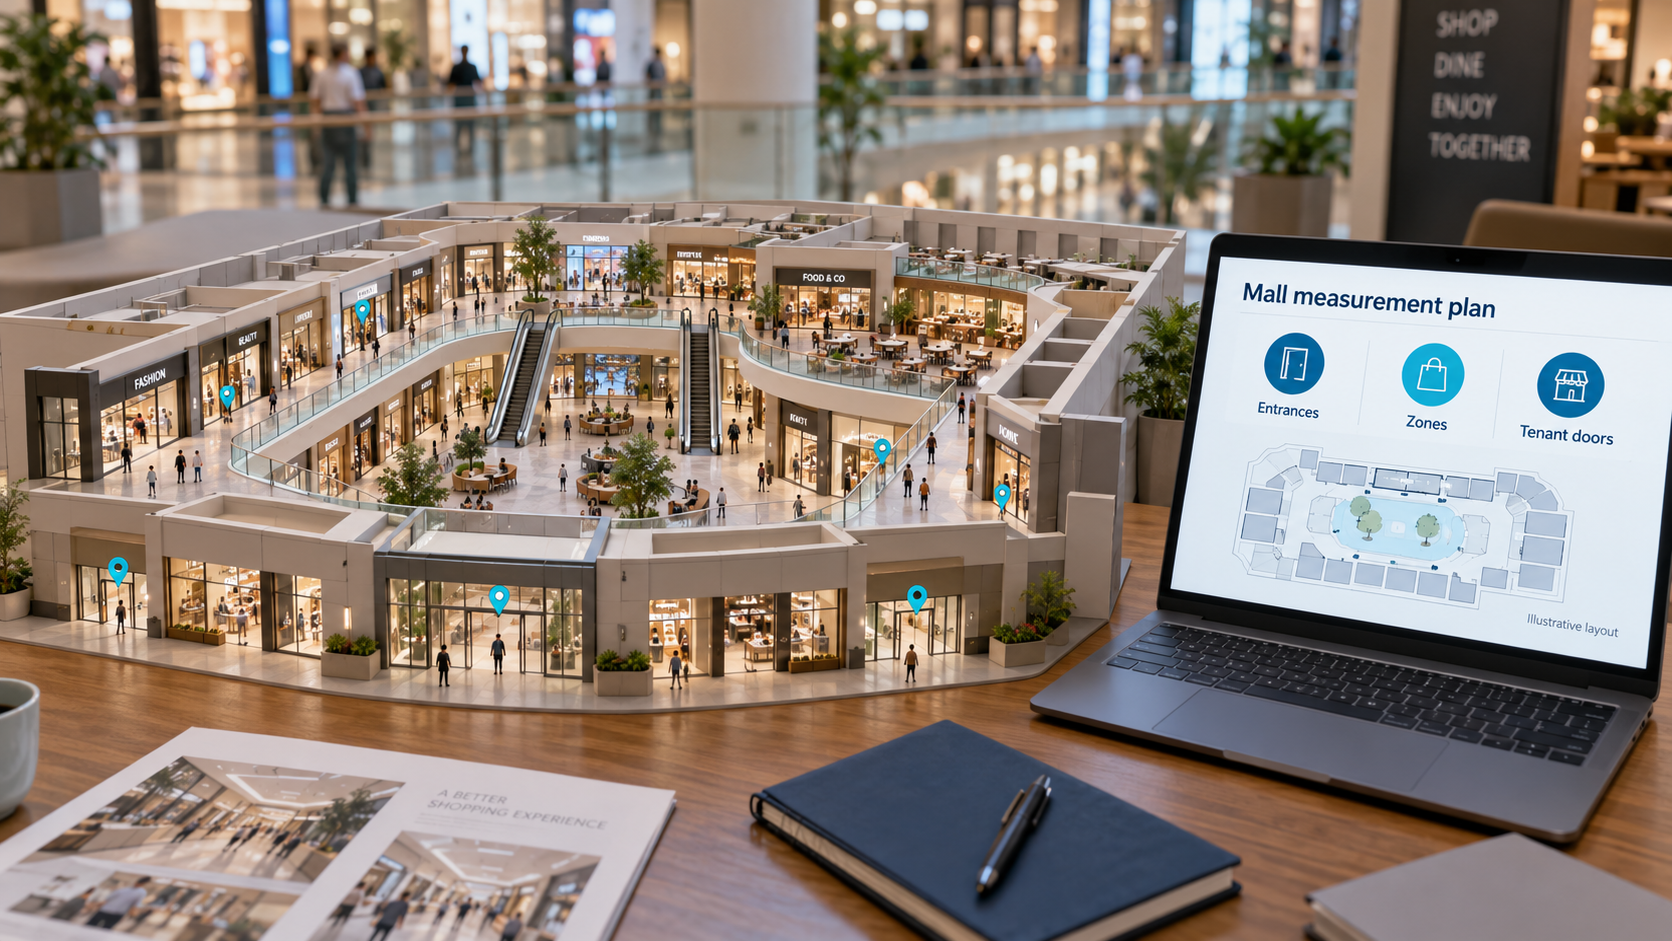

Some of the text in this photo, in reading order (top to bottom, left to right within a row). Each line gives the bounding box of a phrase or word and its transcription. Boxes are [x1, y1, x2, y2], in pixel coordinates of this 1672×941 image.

[1437, 9, 1498, 37] SHOP
[1435, 52, 1484, 77] DINE
[1432, 93, 1496, 119] ENJOY
[1429, 132, 1530, 161] TOGETHER
[803, 273, 824, 282] FOOD
[833, 274, 845, 283] CO
[1243, 282, 1496, 320] Mall measurement plan
[134, 368, 166, 391] FASHION
[1257, 402, 1319, 418] Entrances
[1406, 415, 1447, 430] Zones
[1520, 425, 1614, 445] Tenant doors
[1527, 614, 1619, 638] Illustrative layout
[453, 791, 507, 804] BETTER
[428, 800, 509, 817] SHOPPING
[513, 810, 607, 830] EXPERIENCE
